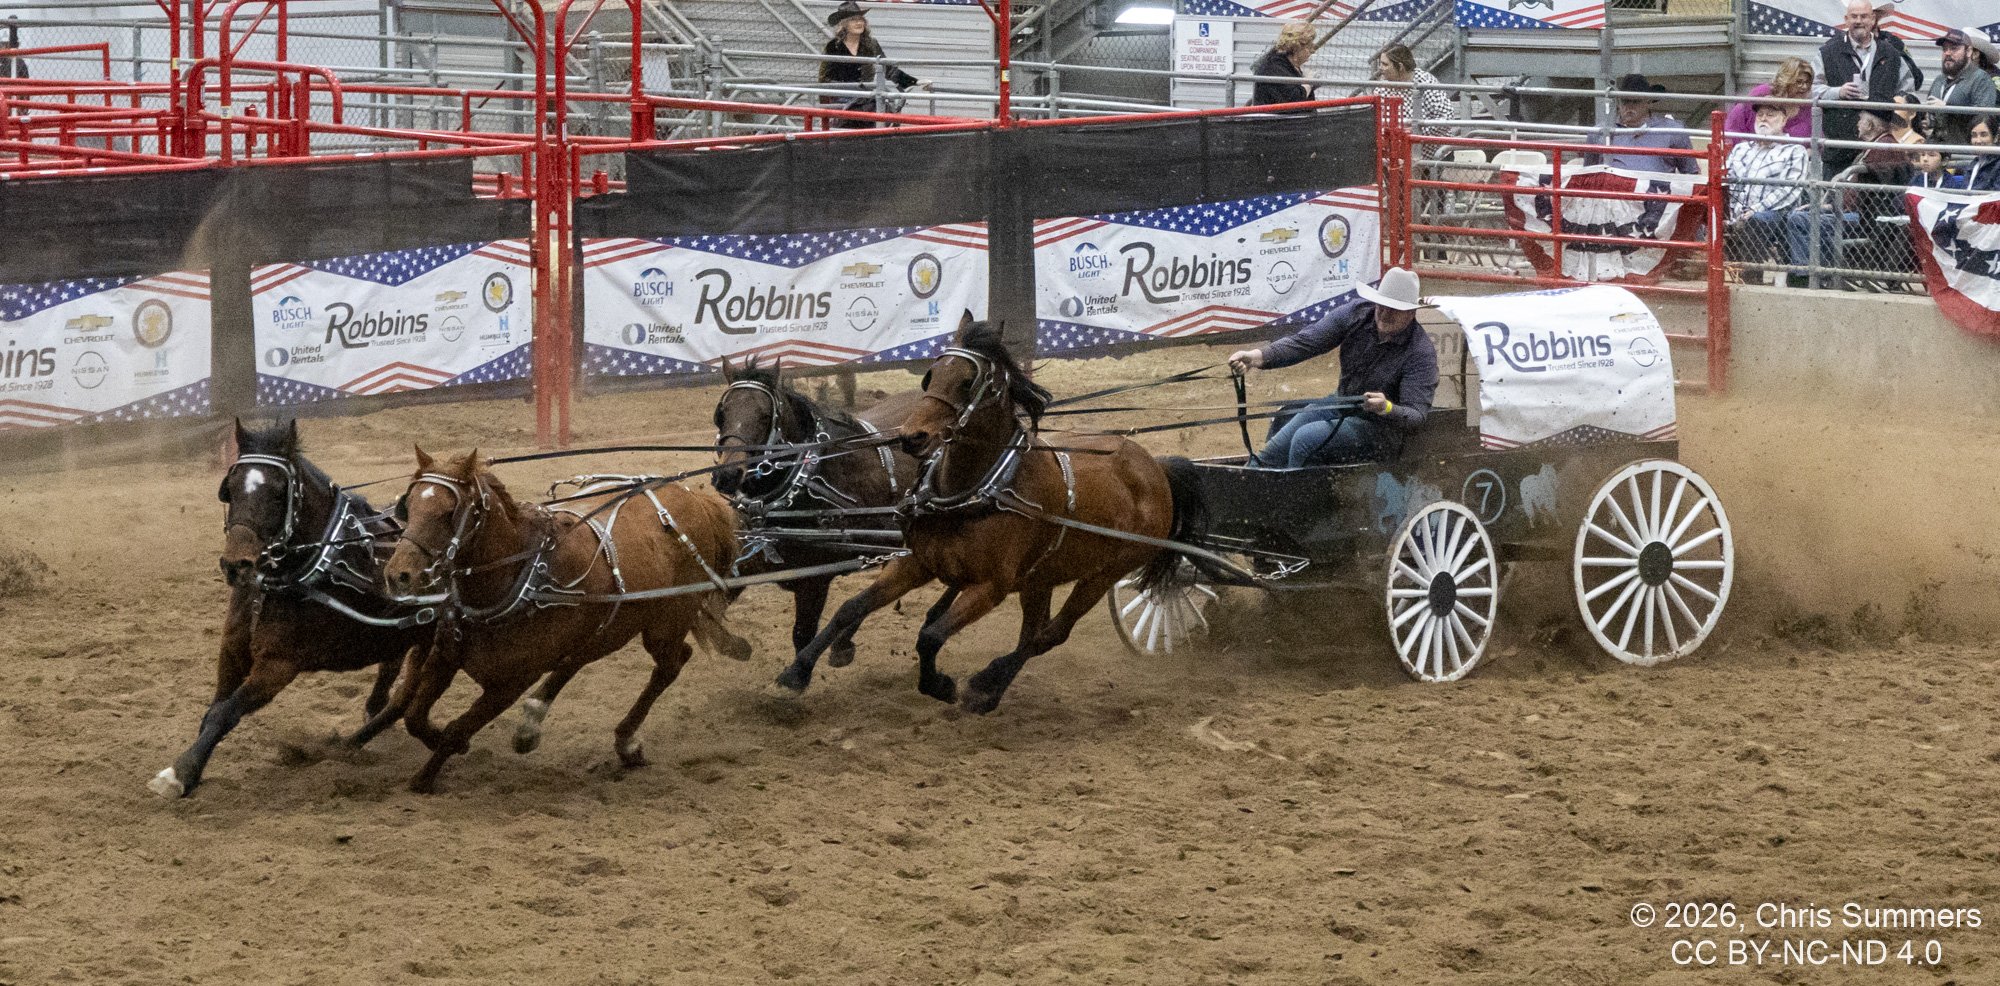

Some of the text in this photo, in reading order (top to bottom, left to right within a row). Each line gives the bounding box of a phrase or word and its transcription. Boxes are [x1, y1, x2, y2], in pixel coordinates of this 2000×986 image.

[1260, 245, 1301, 256] CHEVROLET
[1070, 255, 1108, 271] BUSCH
[1078, 270, 1100, 278] LIGHT
[1120, 241, 1251, 304] Robbins
[1266, 273, 1298, 282] NISSAN
[633, 281, 674, 297] BUSCH
[840, 281, 885, 290] CHEVROLET
[1085, 294, 1118, 306] United
[1182, 287, 1250, 301] Trusted Since 1928
[642, 297, 664, 305] LIGHT
[694, 268, 832, 335] Robbins
[435, 303, 468, 312] CHEVROLET
[1087, 304, 1118, 317] Rentals
[273, 307, 312, 323] BUSCH
[845, 310, 879, 318] NISSAN
[282, 321, 305, 330] LIGHT
[324, 302, 428, 349] Robbins
[648, 324, 683, 334] United
[759, 321, 828, 333] Trusted Since 1928
[1614, 325, 1655, 333] CHEVROLET
[64, 334, 115, 345] CHEVROLET
[371, 338, 395, 346] Trusted
[396, 337, 412, 345] Since
[648, 334, 686, 344] Rentals
[291, 344, 321, 356] United
[1473, 321, 1611, 372] Robbins
[0, 340, 56, 378] ins
[291, 354, 324, 365] Rentals
[1547, 359, 1614, 371] Trusted Since 1928
[71, 366, 109, 375] NISSAN
[8, 382, 32, 392] Since
[33, 380, 54, 390] 1928
[1476, 482, 1493, 514] 7
